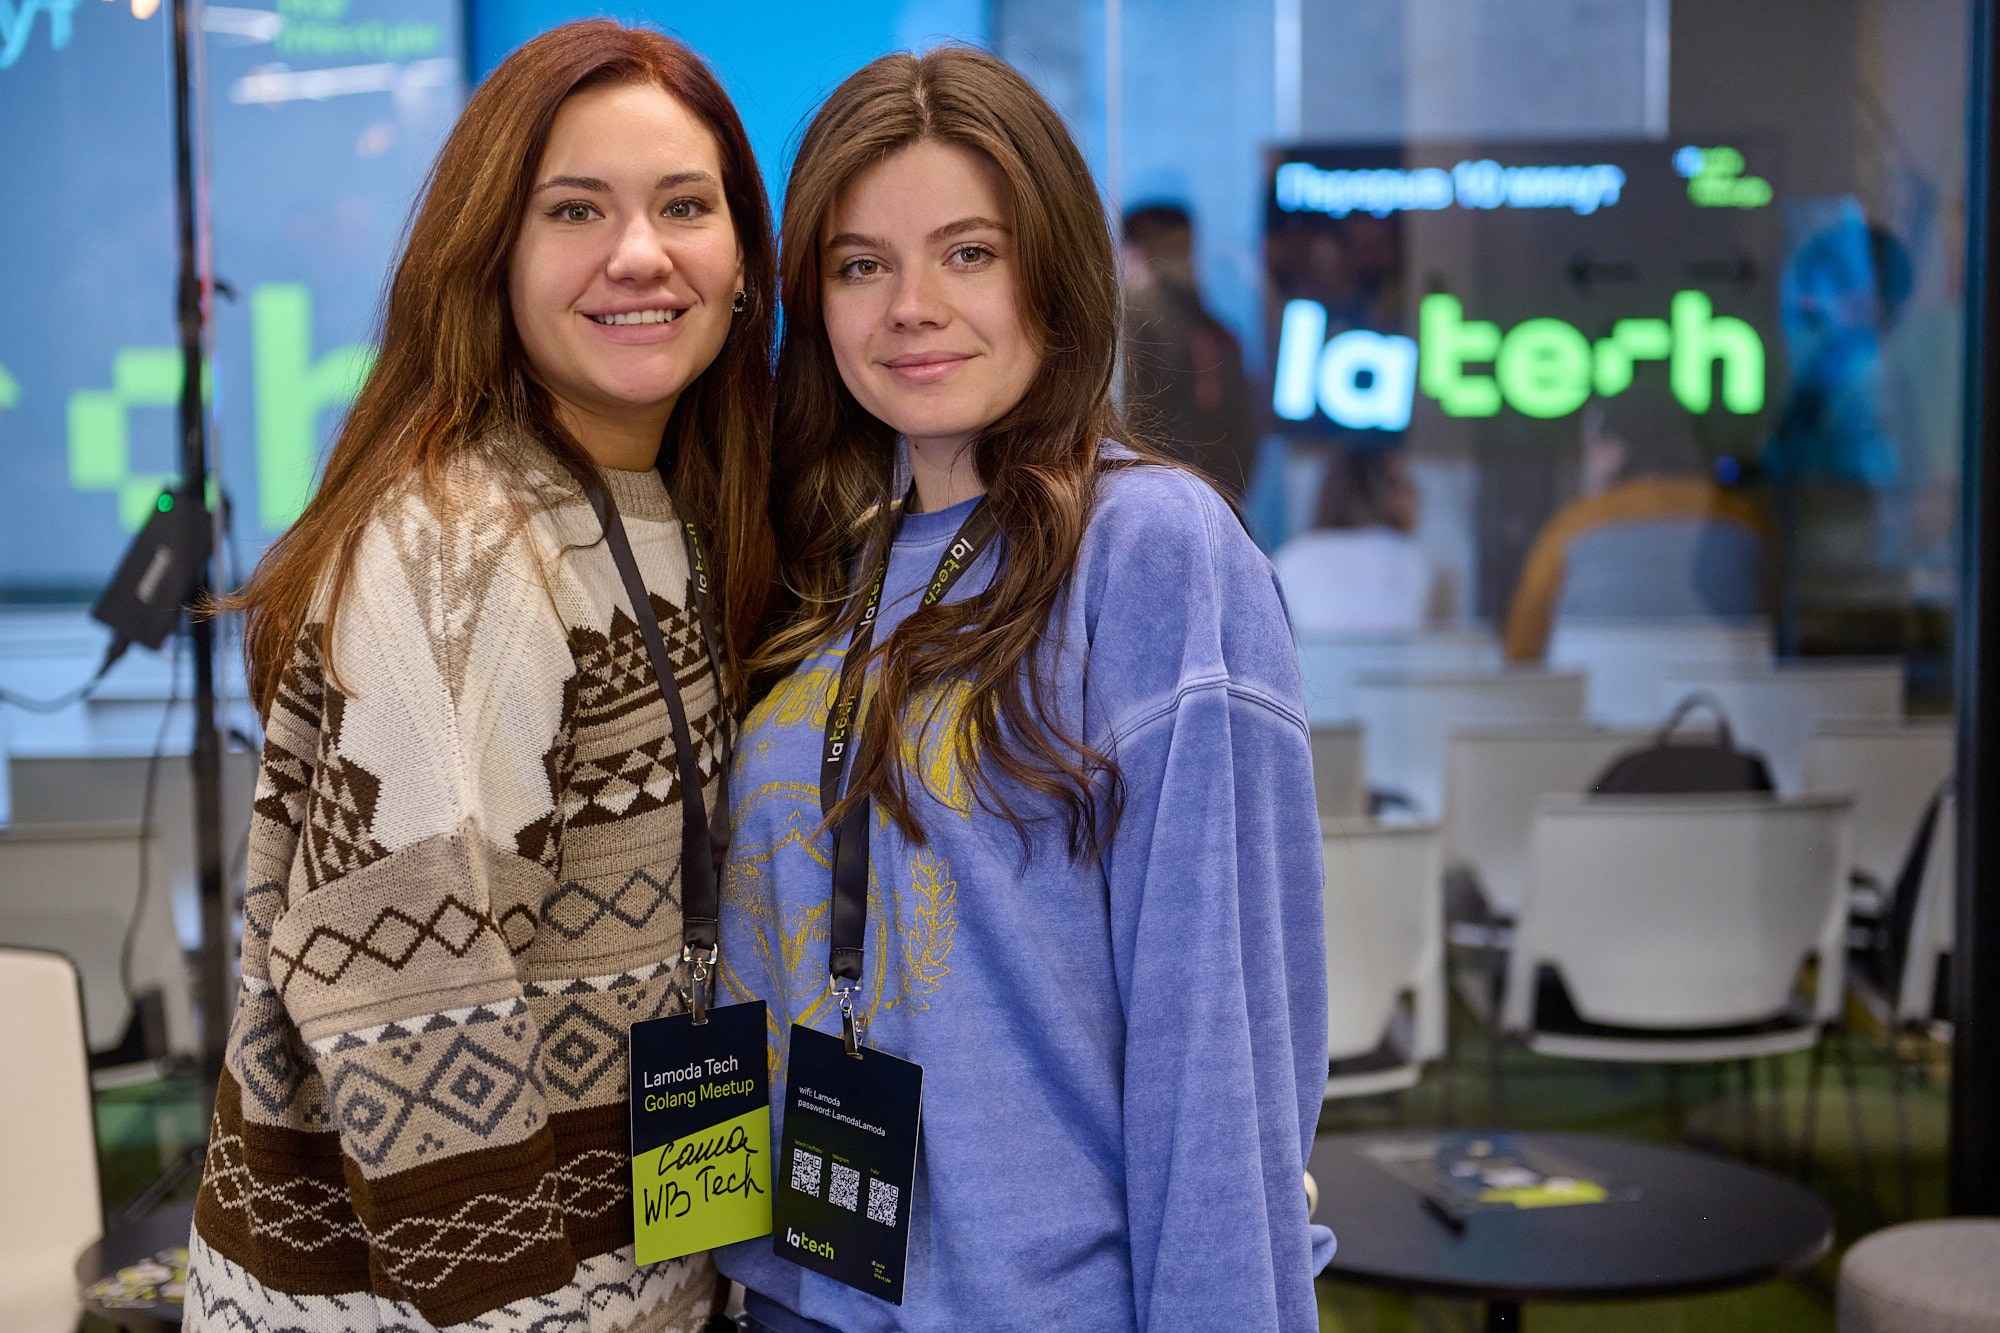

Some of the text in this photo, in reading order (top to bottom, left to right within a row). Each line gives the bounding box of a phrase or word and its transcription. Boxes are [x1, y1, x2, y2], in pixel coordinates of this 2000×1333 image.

[924, 538, 974, 605] latech
[644, 1055, 738, 1088] Lamoda Tech
[644, 1079, 754, 1112] Golang Meetup
[798, 1086, 841, 1107] wifi: Lamoda
[798, 1099, 886, 1137] password: LamodaLamoda
[644, 1153, 764, 1226] WB Tech
[786, 1226, 835, 1261] latech
